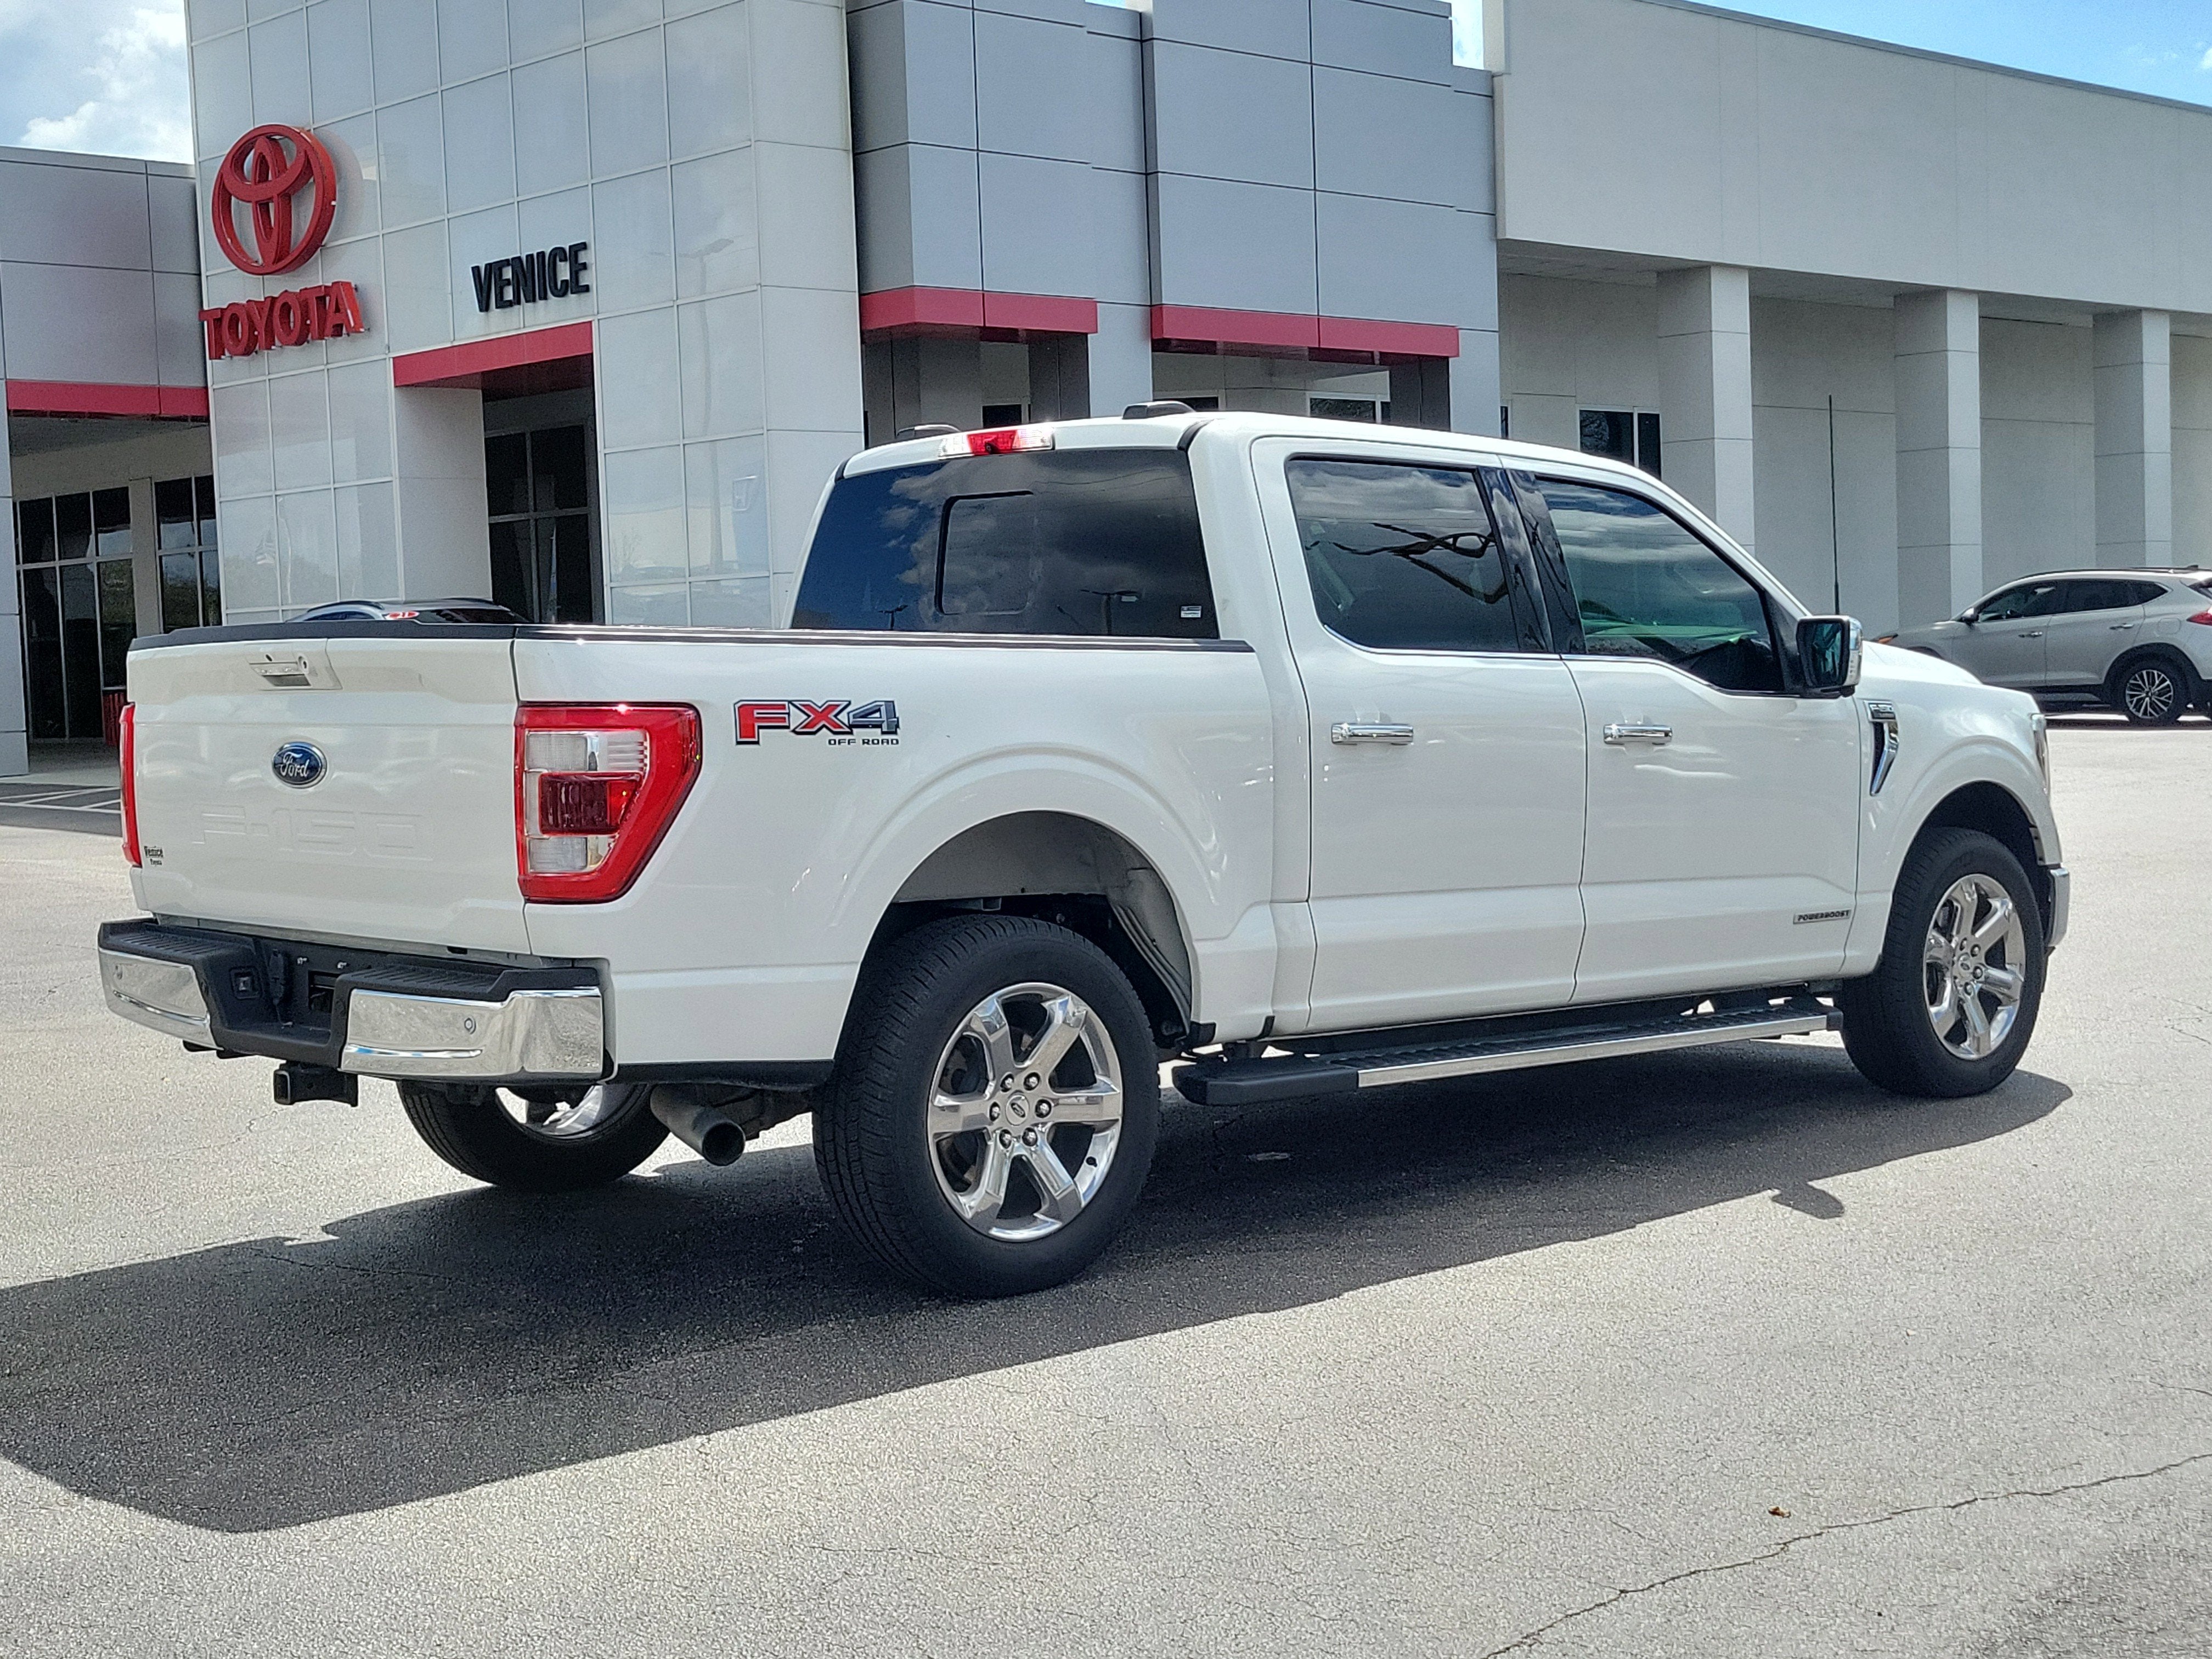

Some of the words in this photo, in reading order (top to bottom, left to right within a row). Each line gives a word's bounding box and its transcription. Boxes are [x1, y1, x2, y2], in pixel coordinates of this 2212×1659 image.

[471, 241, 590, 313] VENICE
[199, 281, 365, 360] TOYOTA
[733, 699, 901, 746] FX4
[280, 751, 311, 777] Ford
[190, 803, 433, 861] F-150
